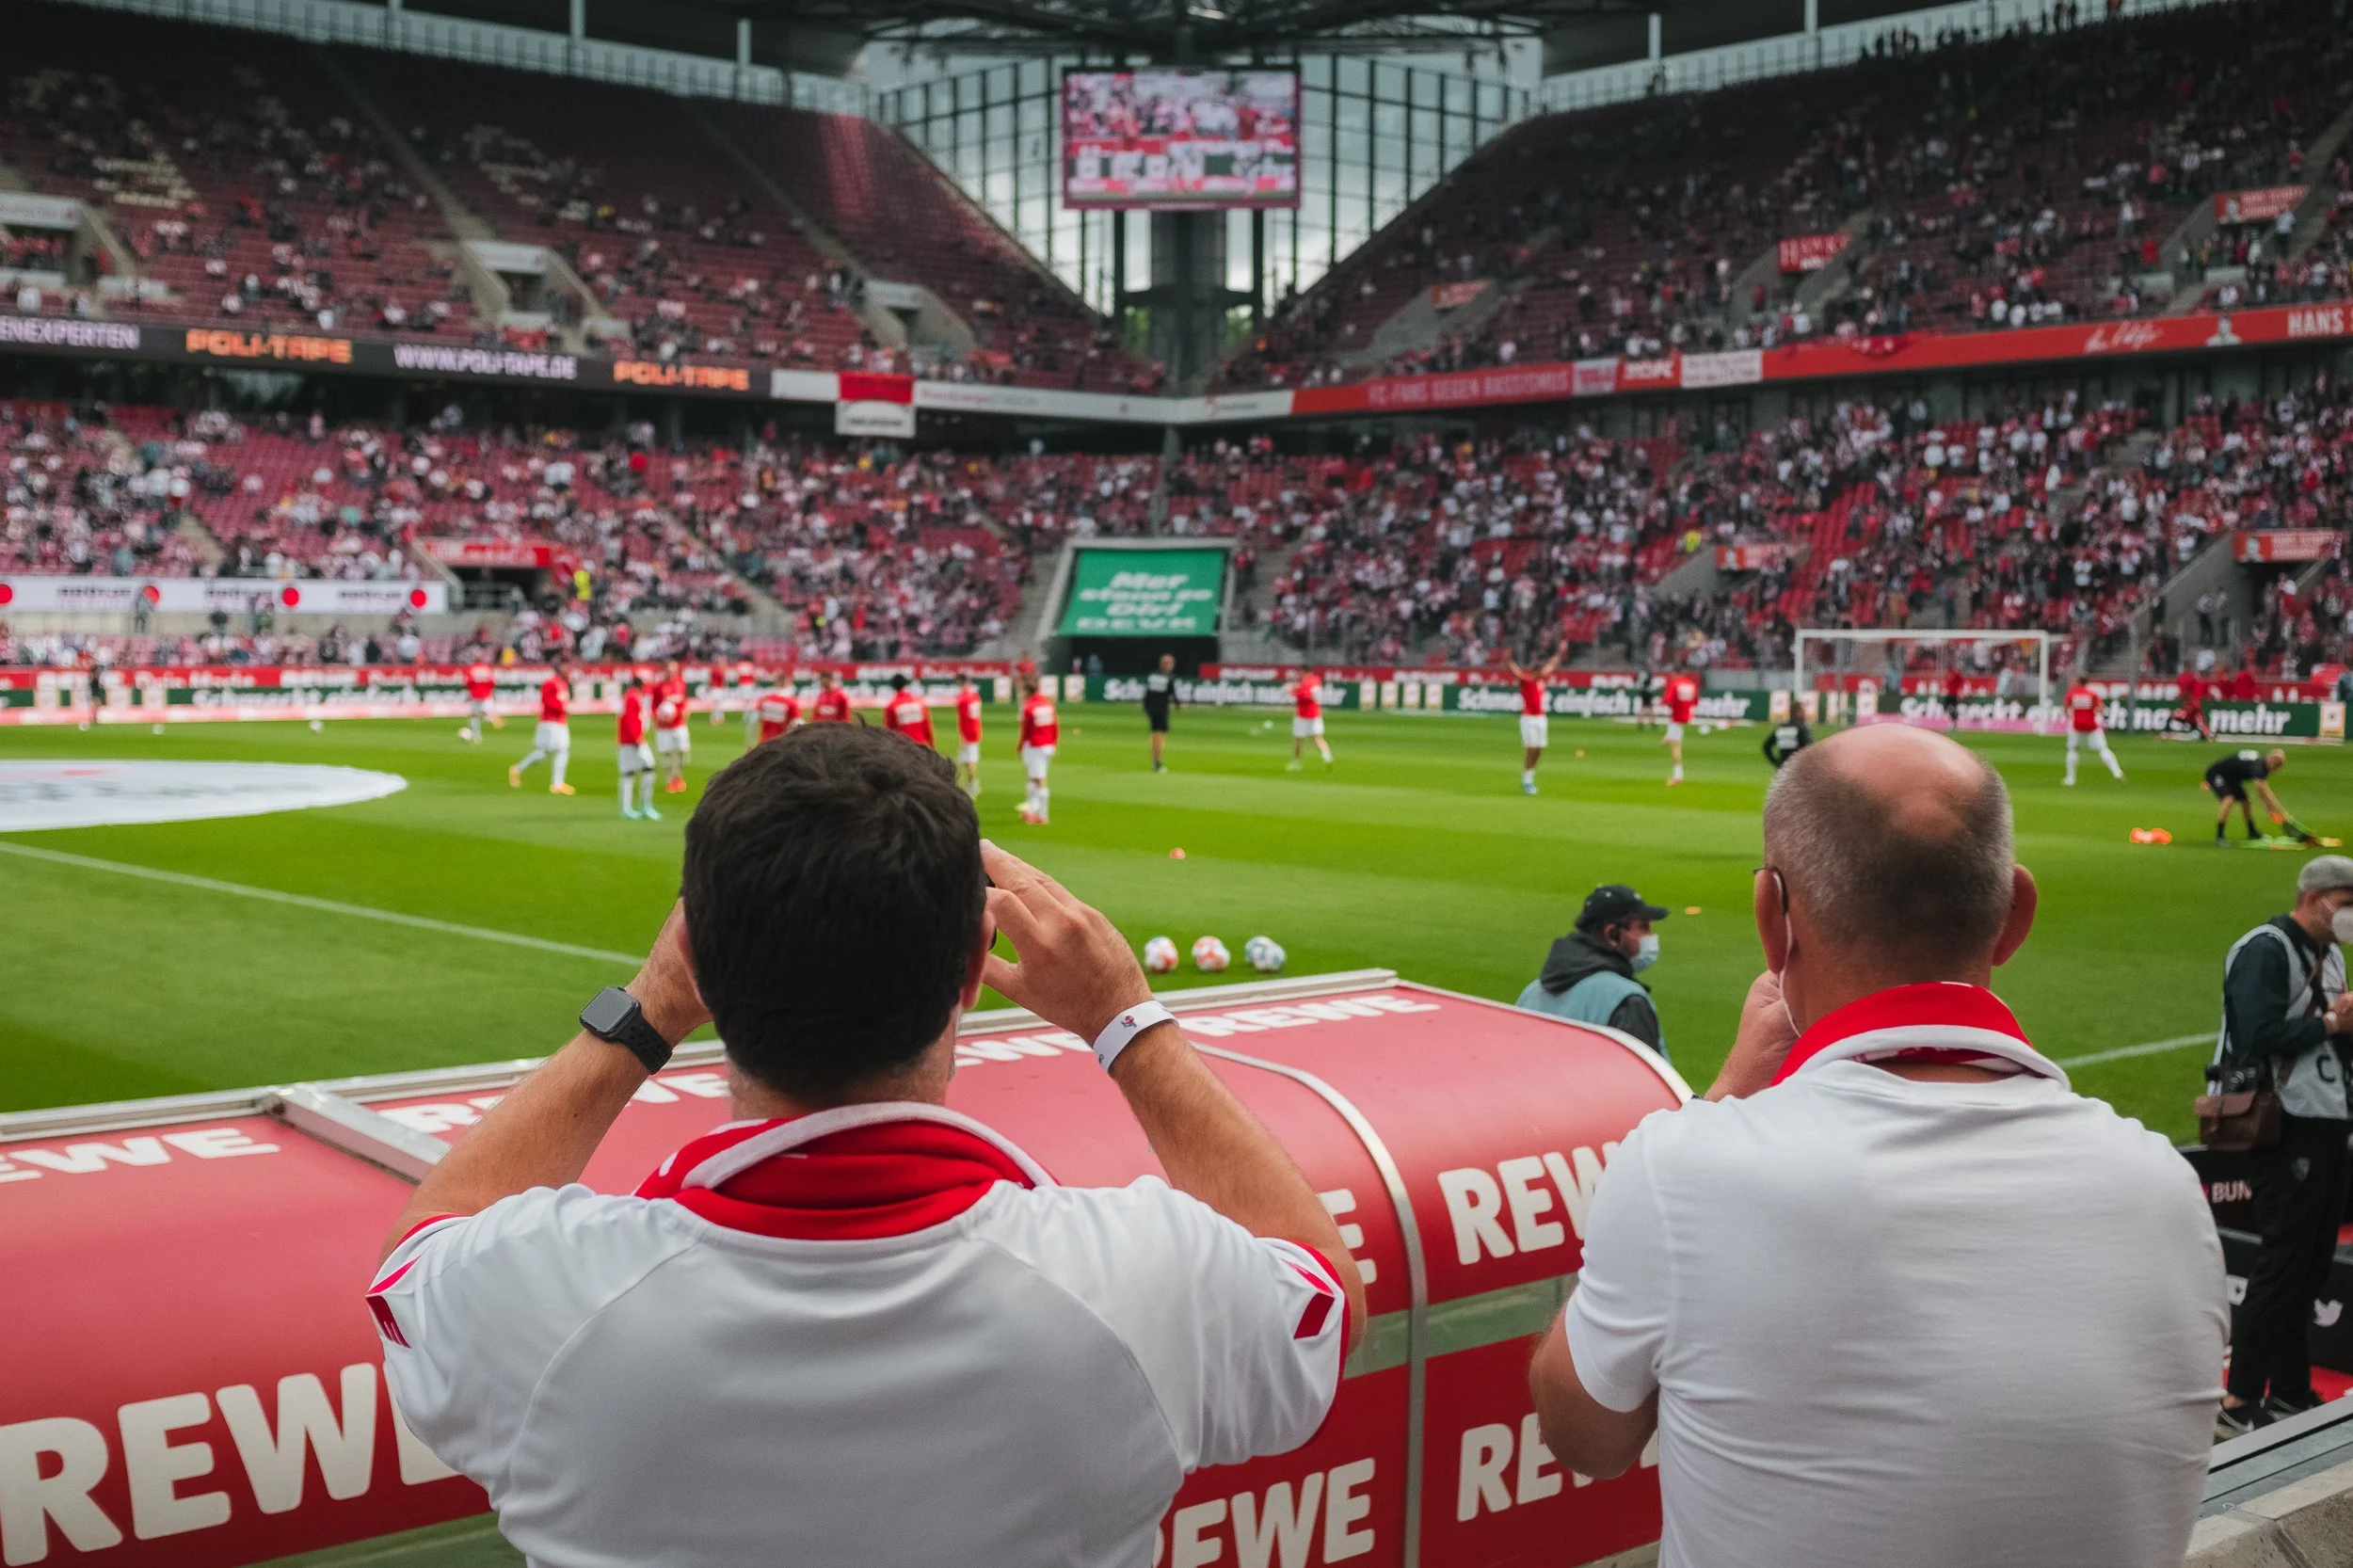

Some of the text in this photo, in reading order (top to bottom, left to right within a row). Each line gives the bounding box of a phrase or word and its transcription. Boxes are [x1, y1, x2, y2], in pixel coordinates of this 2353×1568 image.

[2210, 702, 2291, 735] mehr
[1178, 995, 1441, 1036] REWE
[1437, 1141, 1621, 1266] REW
[1152, 1457, 1376, 1568] EWE
[1457, 1412, 1658, 1523] RE
